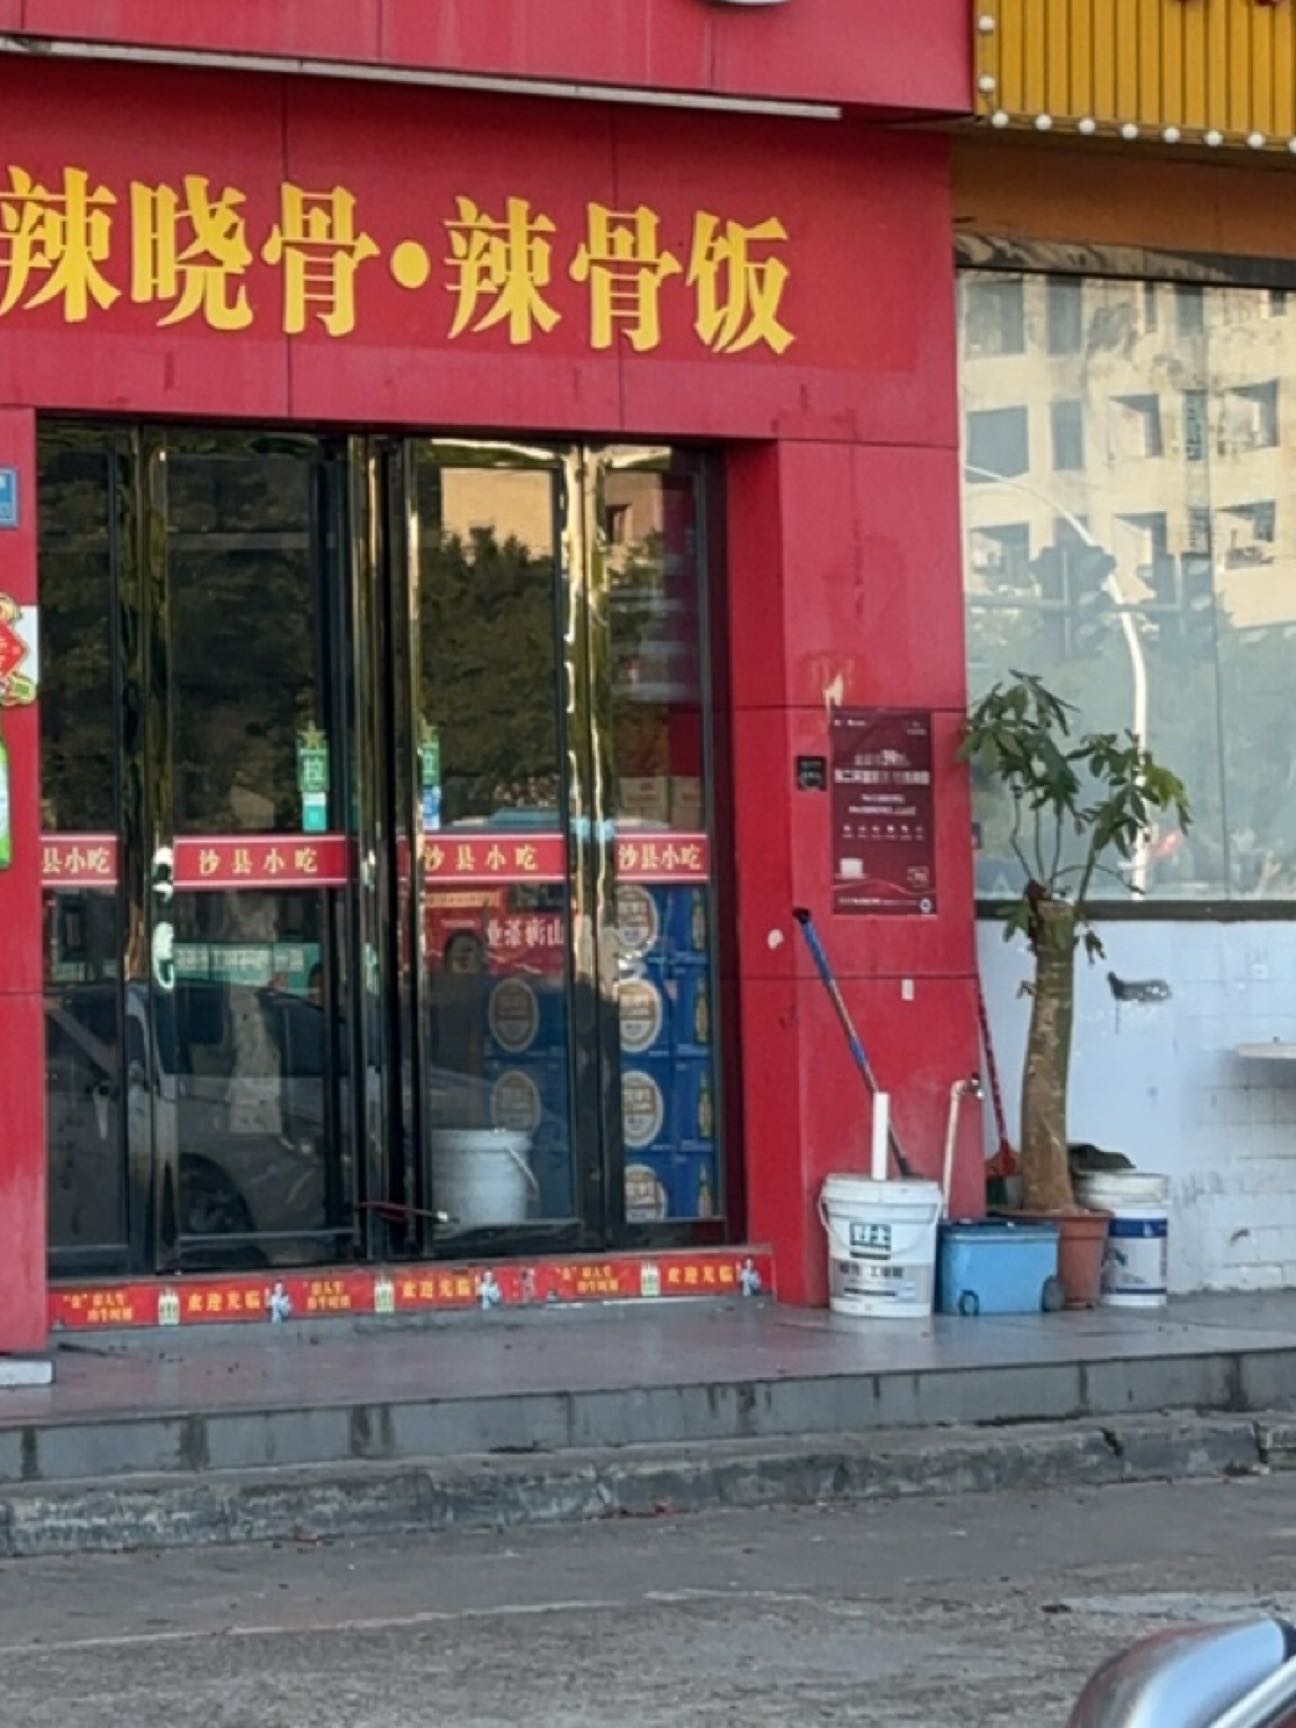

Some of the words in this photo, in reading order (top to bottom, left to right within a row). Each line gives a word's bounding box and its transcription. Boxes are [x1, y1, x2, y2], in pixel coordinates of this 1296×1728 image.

[198, 849, 318, 874] 沙县小吃
[424, 845, 536, 871] 沙县小吃
[618, 843, 702, 870] 沙县小吃
